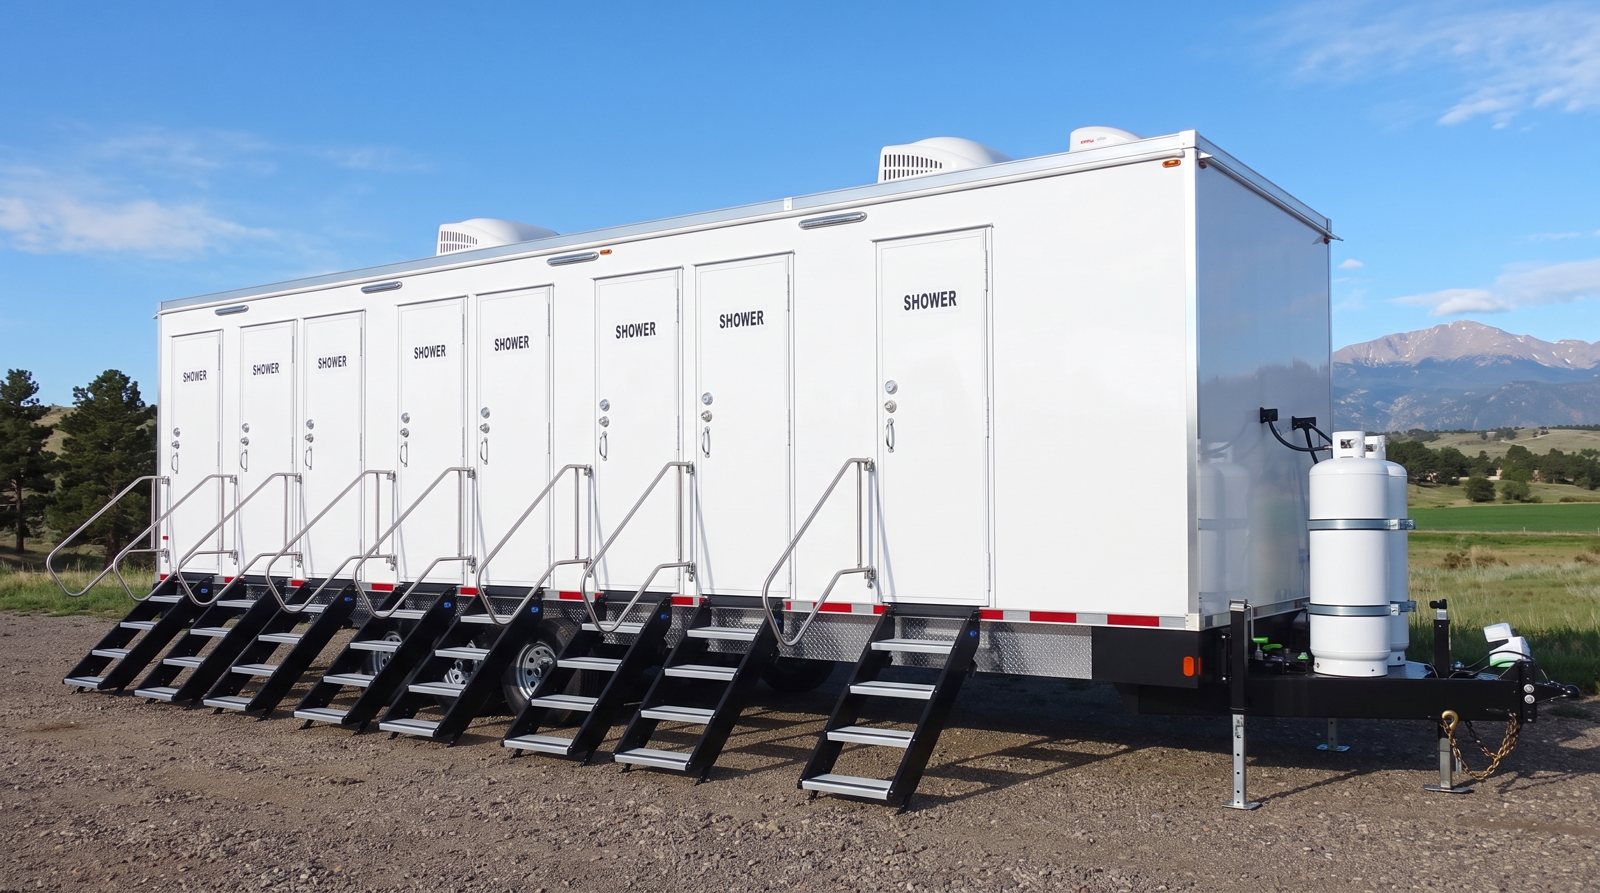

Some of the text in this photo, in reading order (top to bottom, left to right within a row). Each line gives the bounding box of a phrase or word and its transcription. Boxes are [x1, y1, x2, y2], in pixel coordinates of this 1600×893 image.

[903, 290, 957, 311] SHOWER
[719, 310, 764, 329] SHOWER
[615, 321, 656, 339] SHOWER
[494, 335, 529, 351] SHOWER
[414, 344, 446, 360] SHOWER
[252, 362, 280, 376] SHOWER
[318, 355, 347, 369] SHOWER
[183, 369, 207, 383] SHOWER
